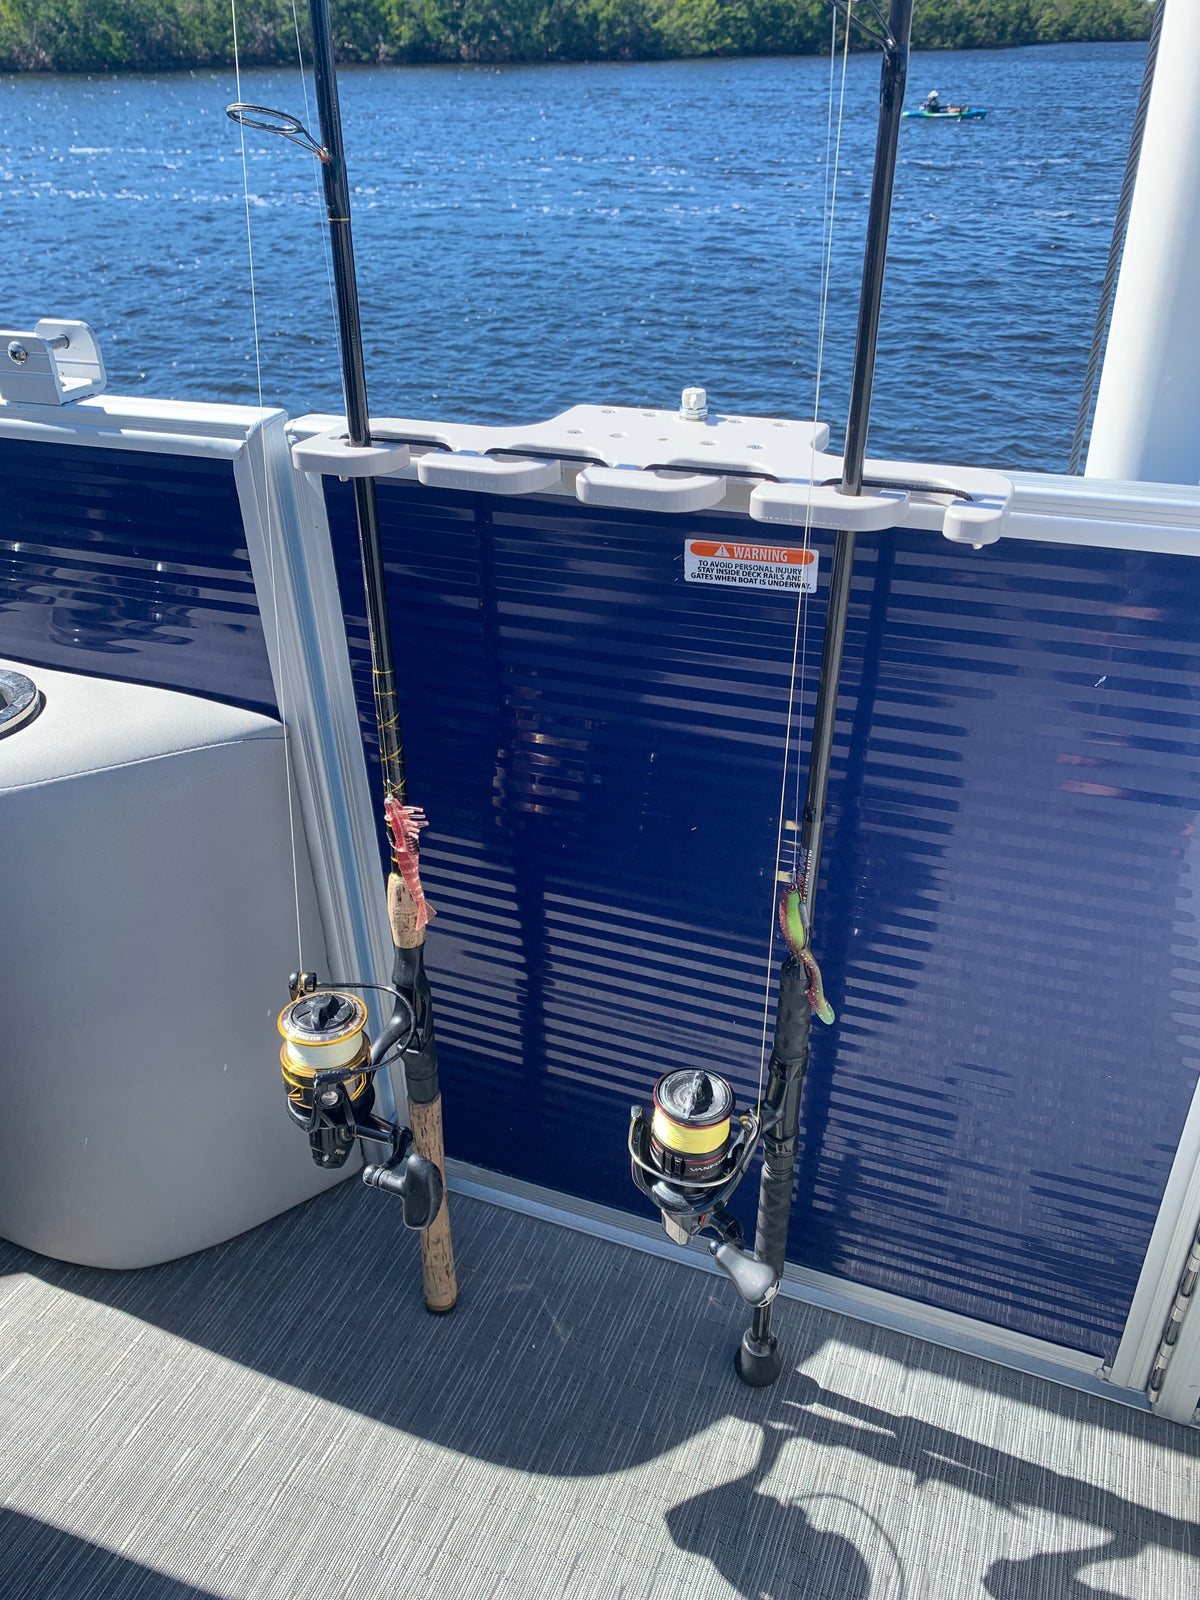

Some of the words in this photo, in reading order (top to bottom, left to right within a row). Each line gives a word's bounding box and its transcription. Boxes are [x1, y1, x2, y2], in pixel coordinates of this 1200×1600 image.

[733, 546, 788, 562] WARNING
[698, 566, 715, 574] STAY
[716, 568, 741, 577] INSIDE
[742, 570, 762, 578] DECK
[710, 561, 733, 569] AVOID
[735, 563, 773, 573] PERSONAL
[775, 567, 803, 575] INJURY
[691, 572, 714, 580] GATES
[714, 574, 737, 583] WHEN
[738, 577, 758, 585] BOAT
[768, 579, 812, 590] UNDERWAY.
